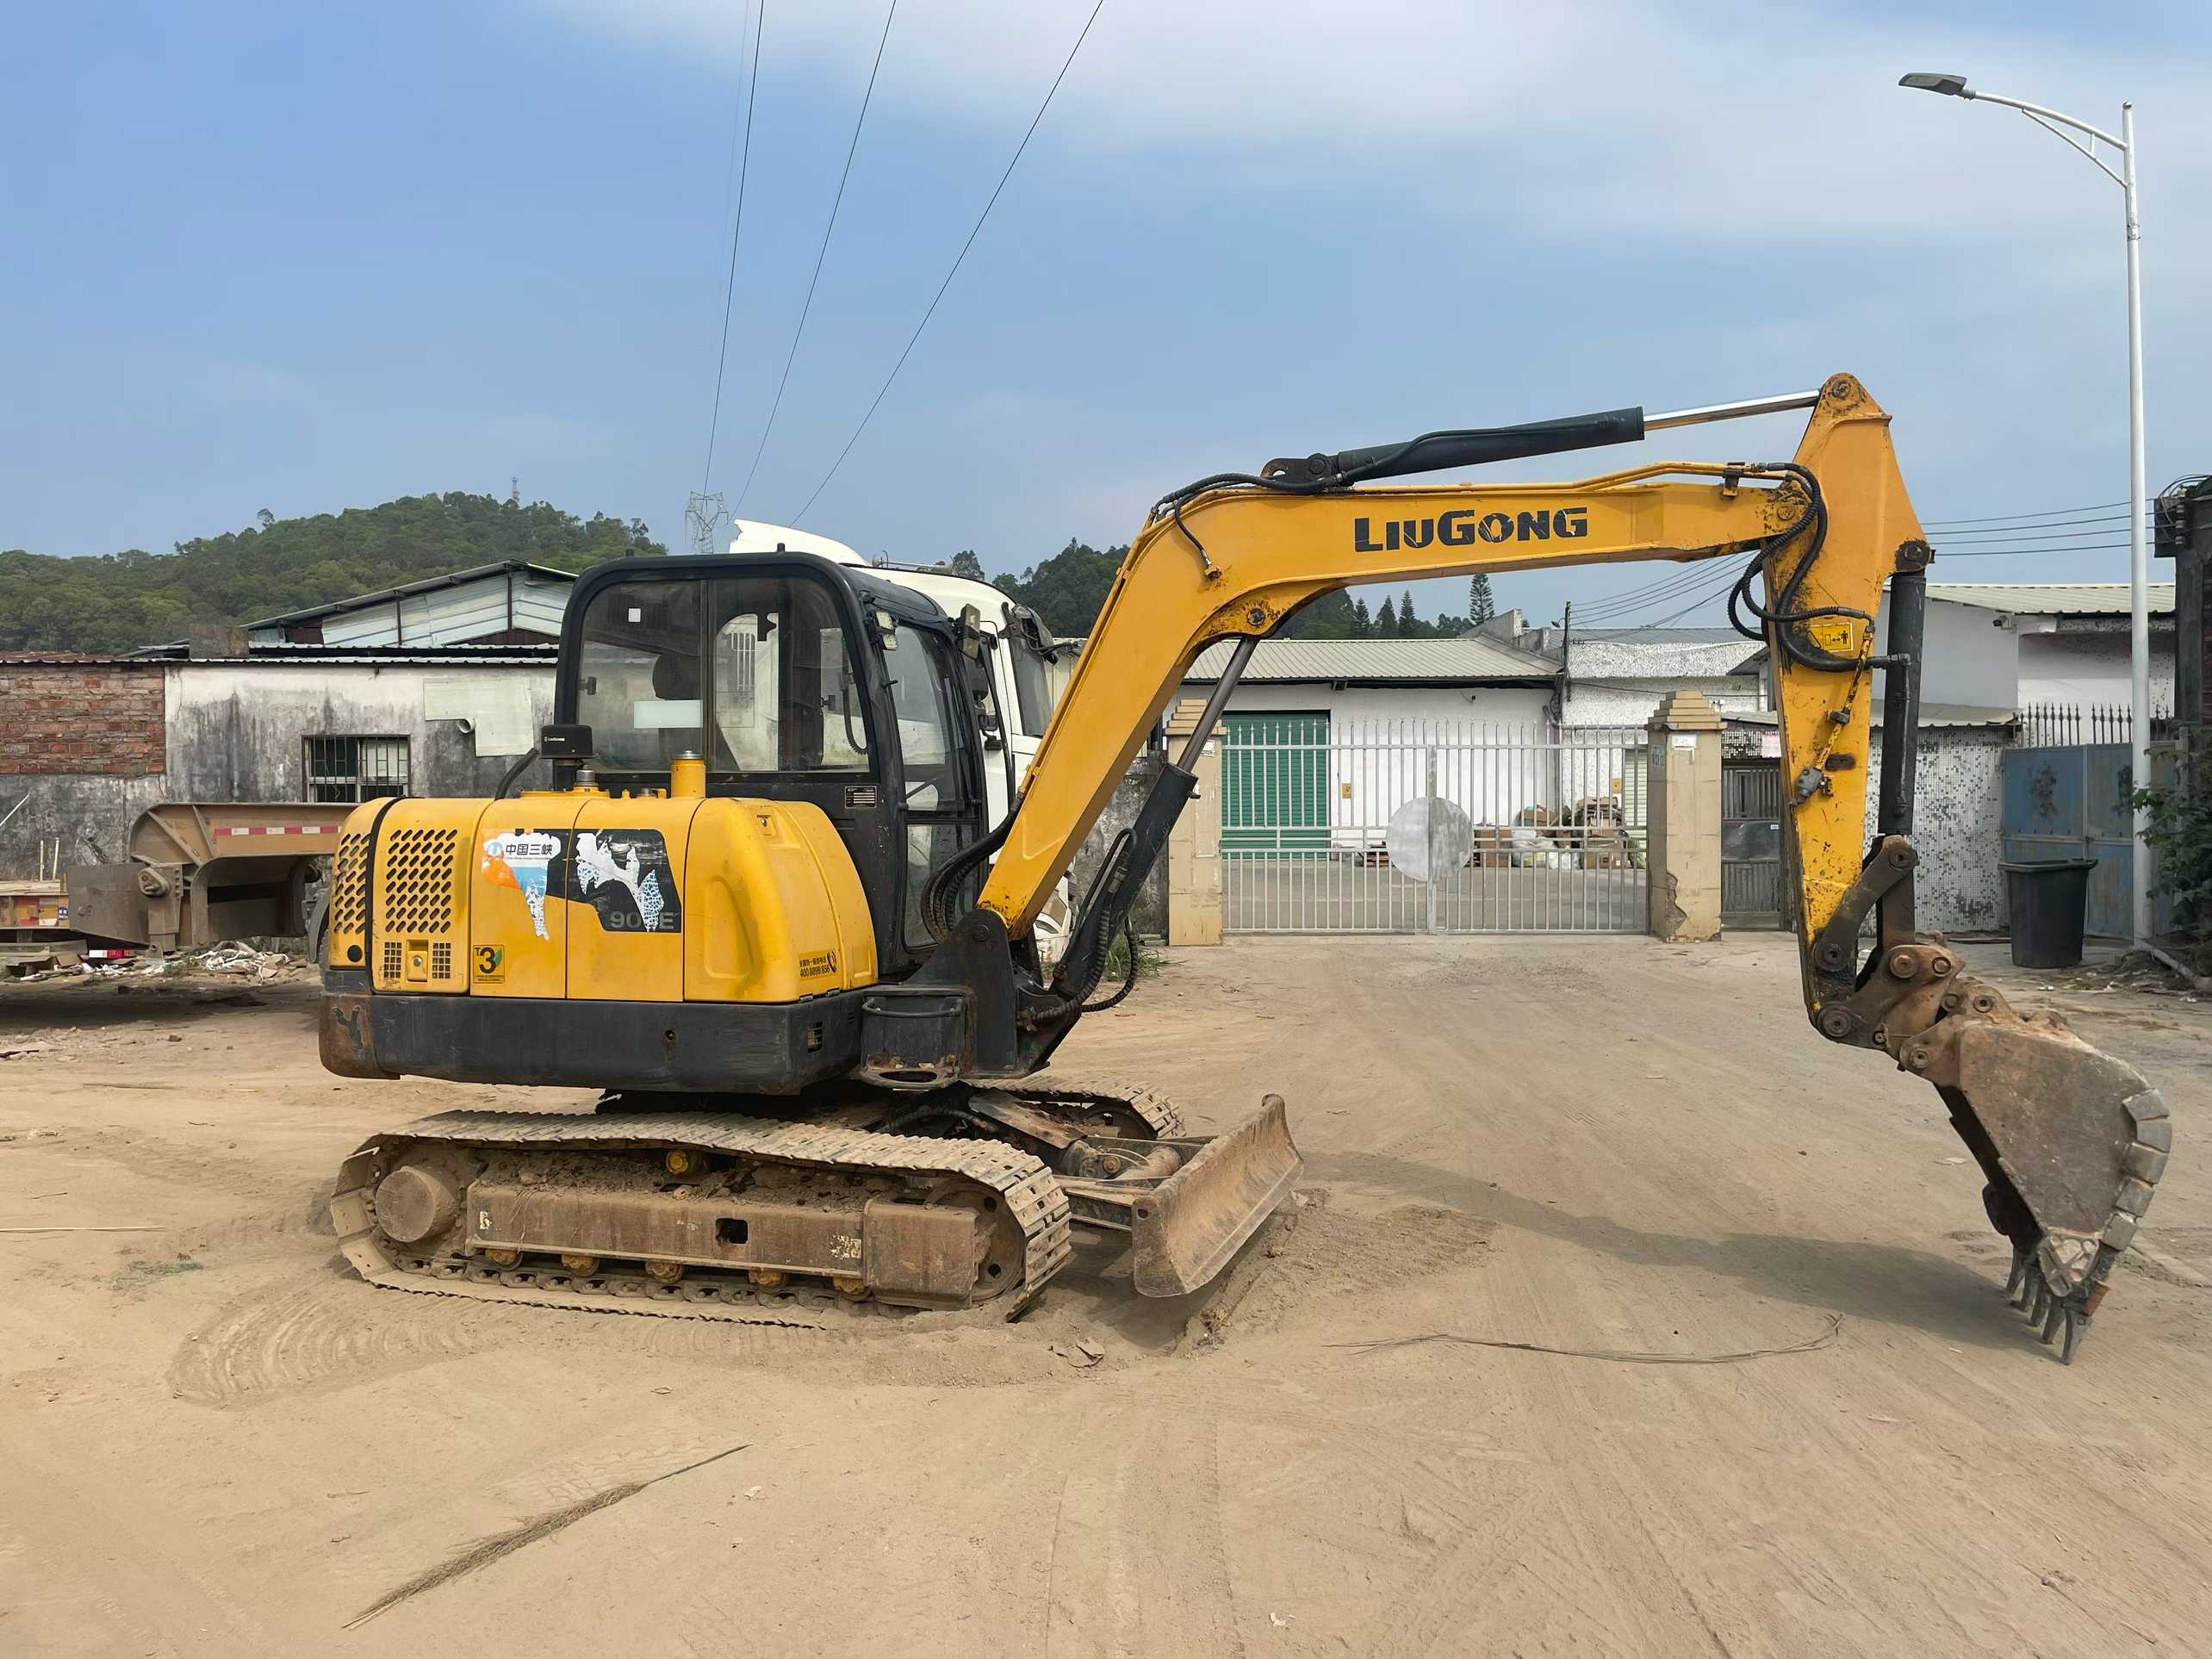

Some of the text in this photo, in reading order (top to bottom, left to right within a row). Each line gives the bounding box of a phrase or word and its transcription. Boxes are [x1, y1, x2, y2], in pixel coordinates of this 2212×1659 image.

[1354, 506, 1588, 553] LIUGONG
[506, 843, 553, 855] 中国三峡
[610, 911, 674, 929] 90E
